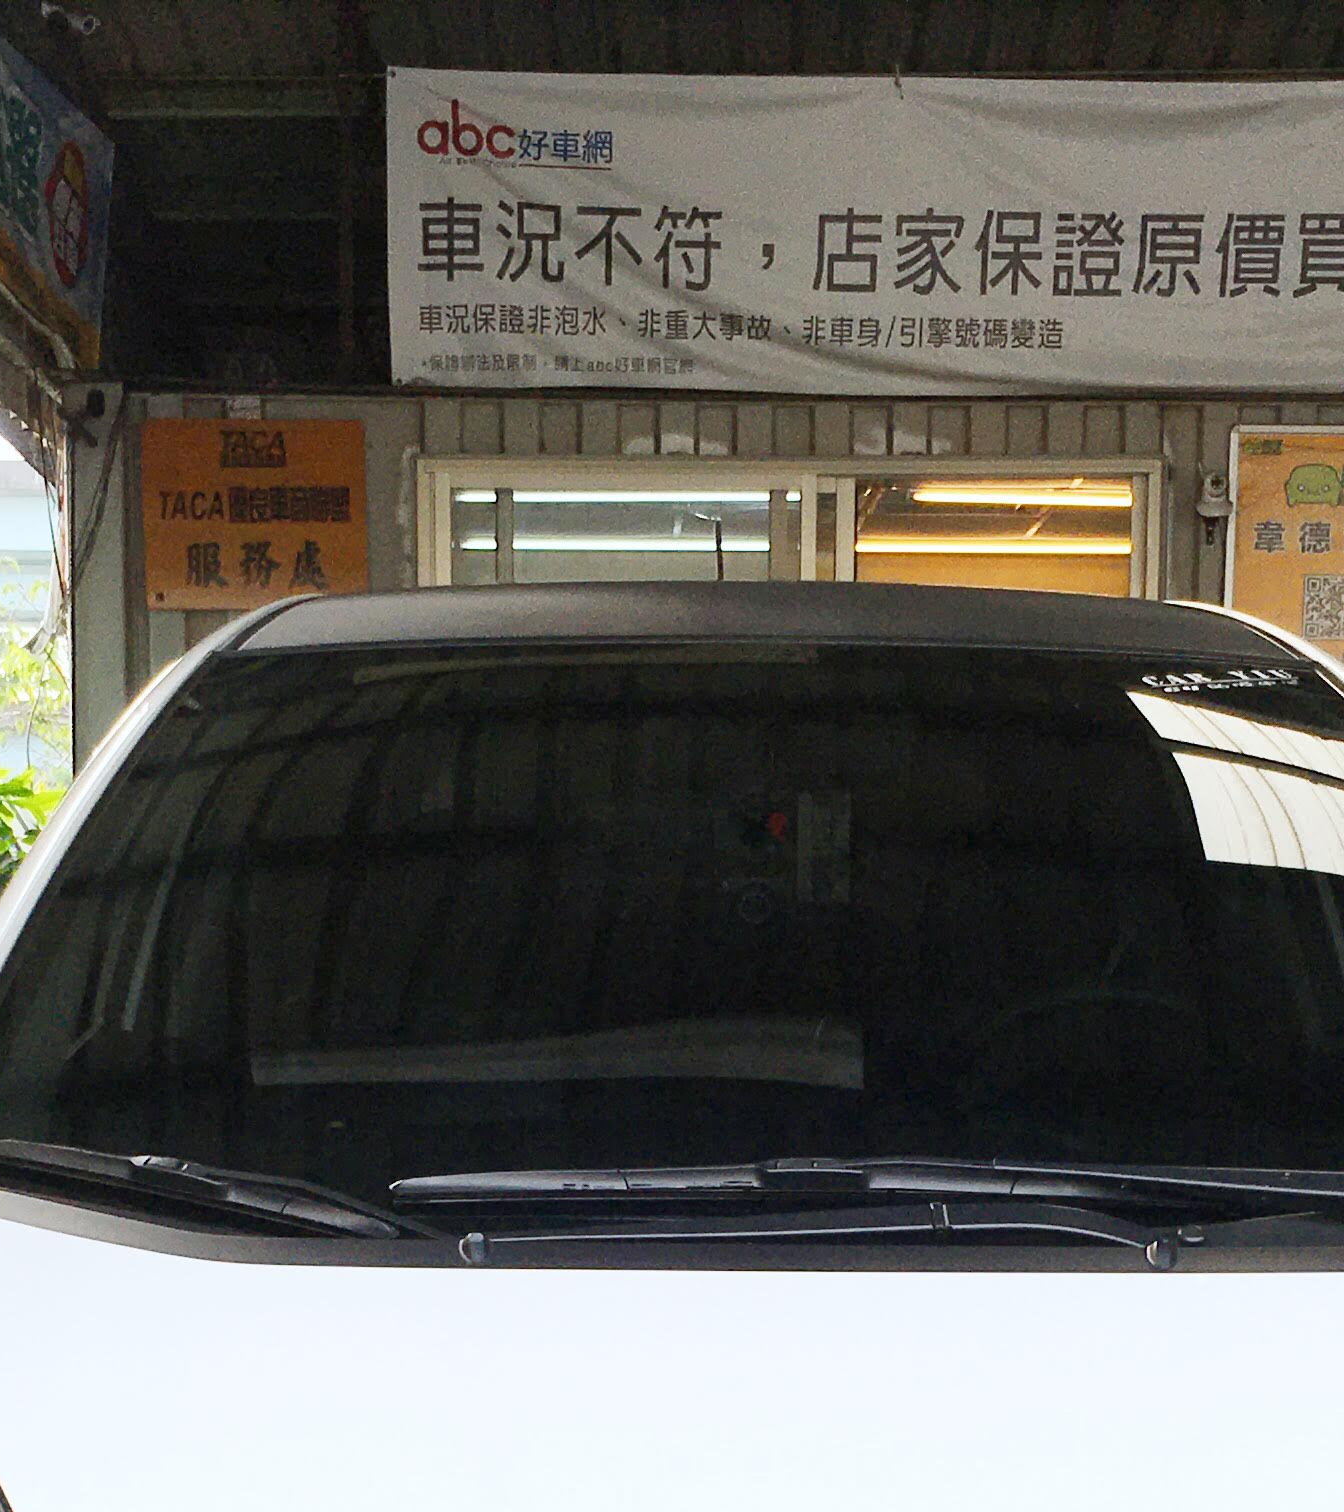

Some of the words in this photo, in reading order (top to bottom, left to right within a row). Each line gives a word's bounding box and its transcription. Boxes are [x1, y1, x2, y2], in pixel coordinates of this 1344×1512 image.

[417, 99, 515, 159] abc
[517, 129, 613, 163] 好車網
[159, 490, 224, 520] TACA
